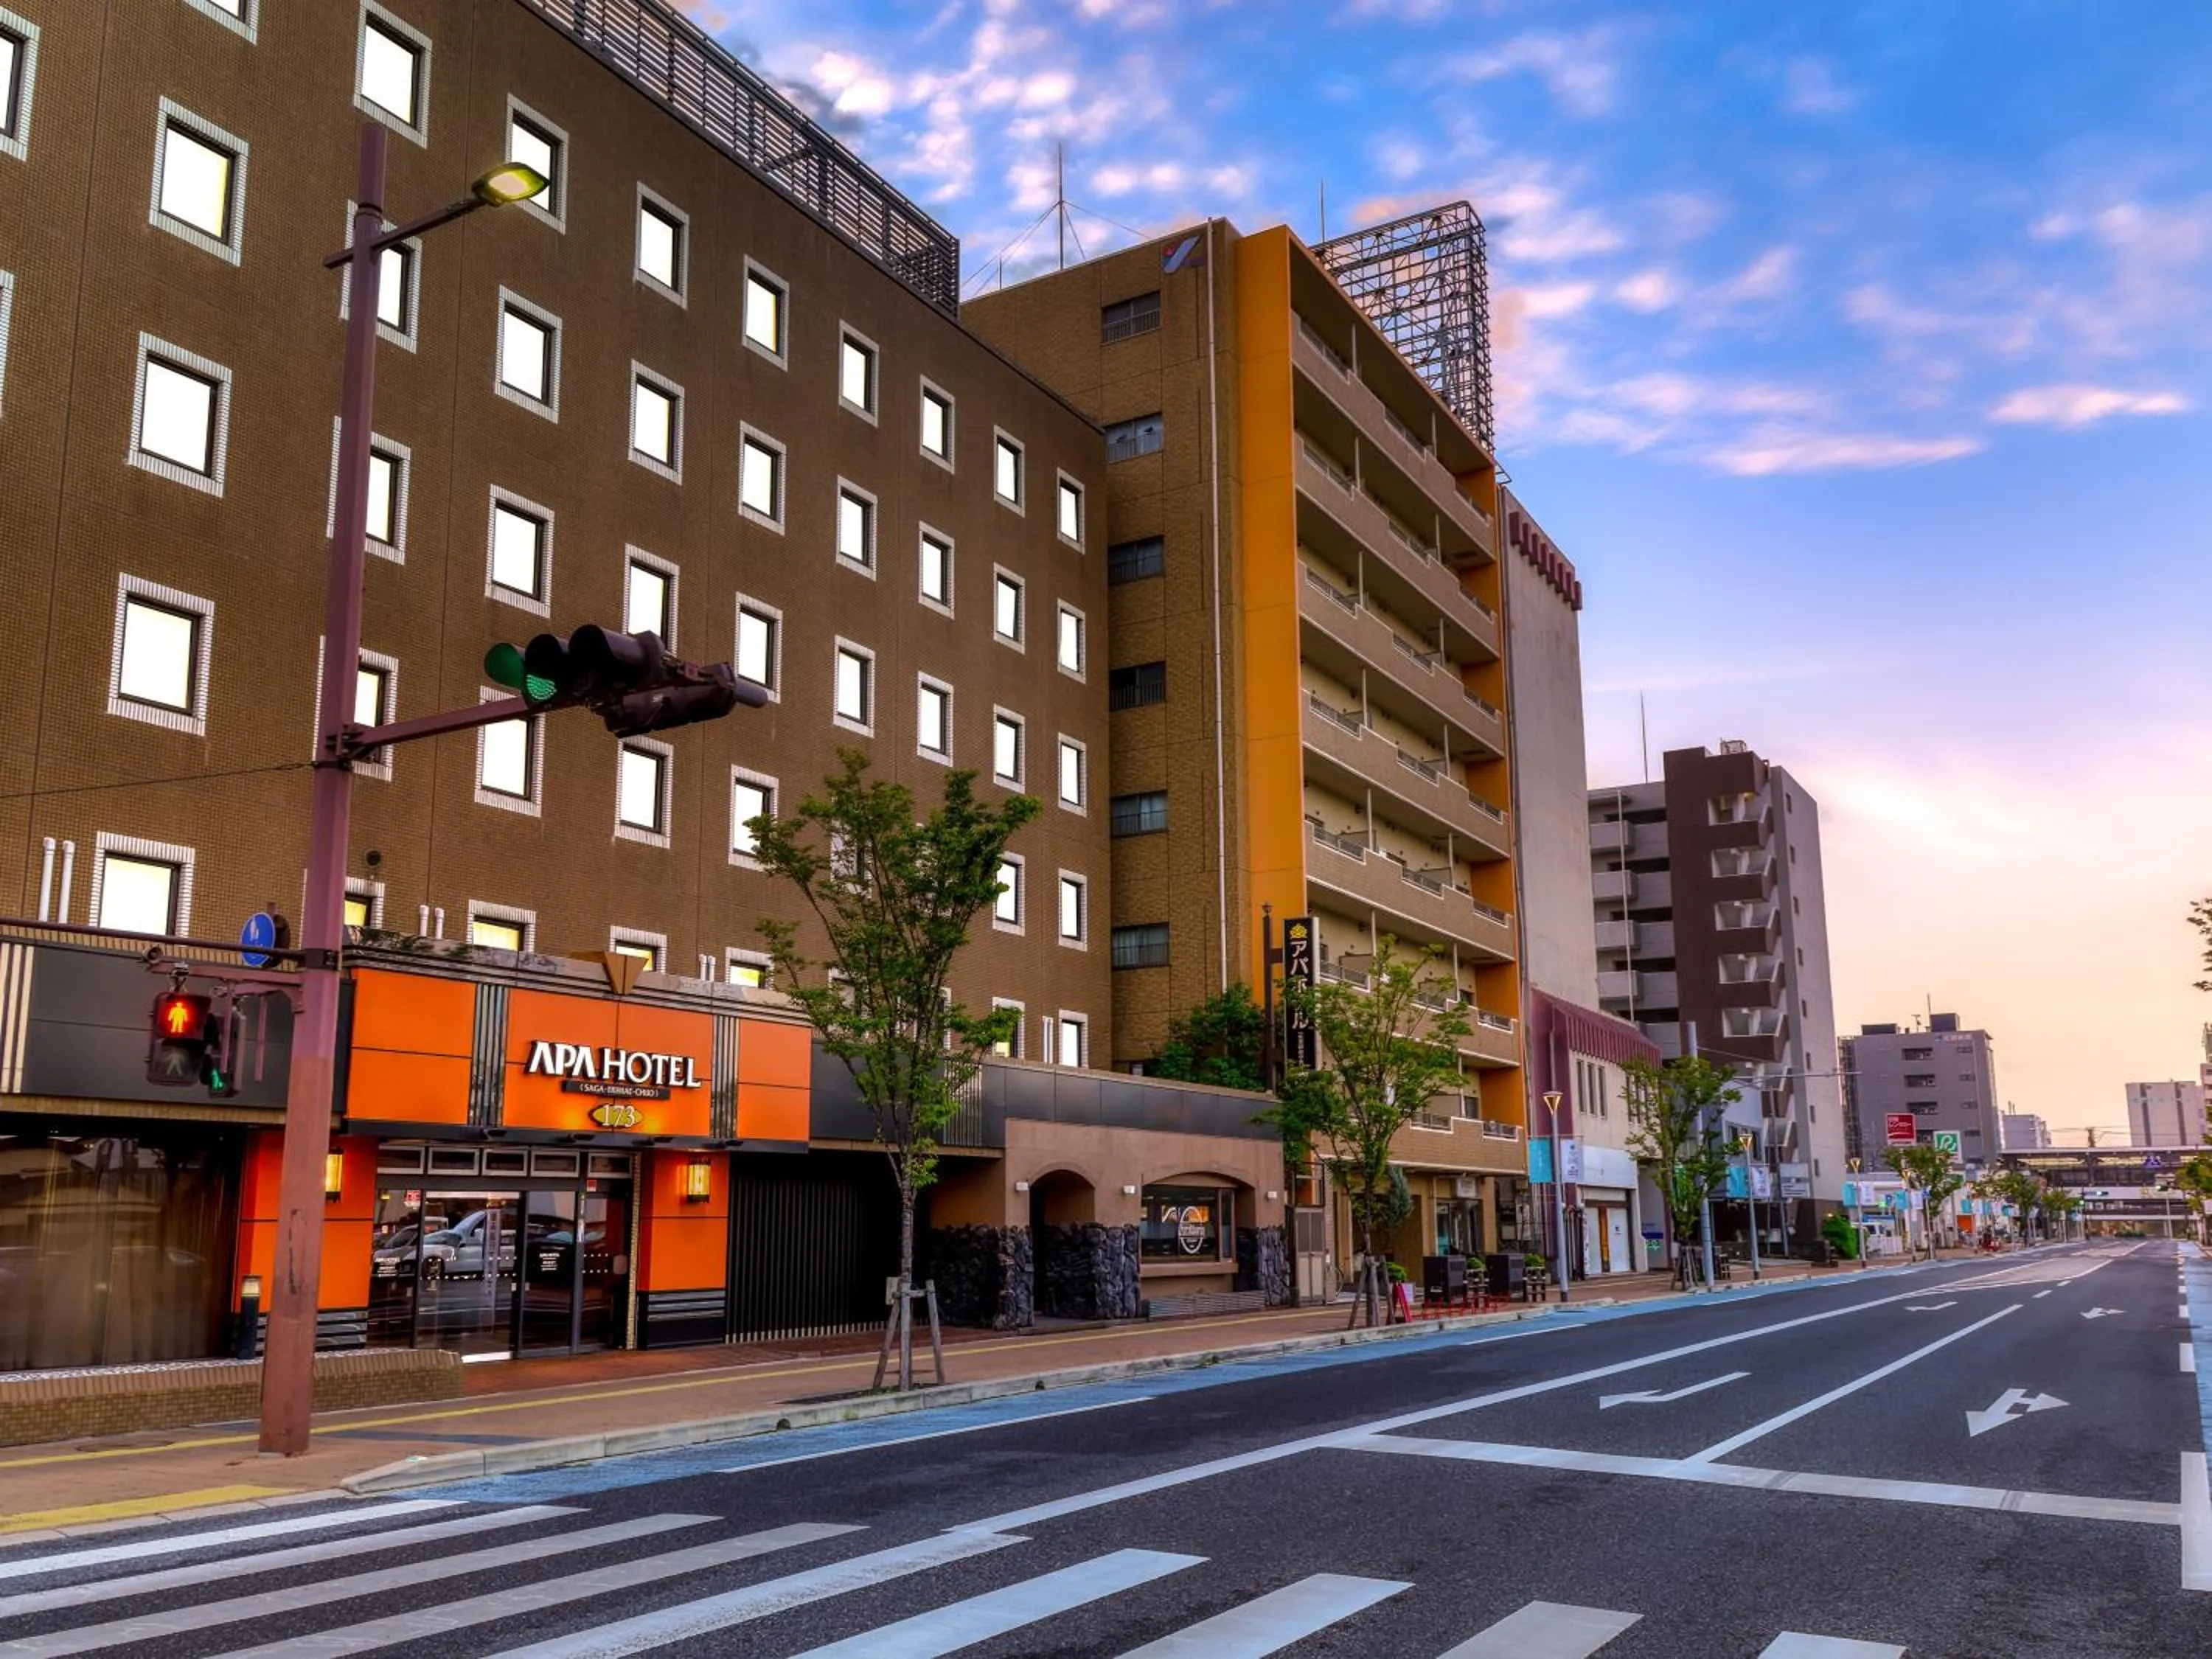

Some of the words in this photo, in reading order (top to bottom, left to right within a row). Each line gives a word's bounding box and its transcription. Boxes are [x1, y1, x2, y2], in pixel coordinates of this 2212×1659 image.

[1290, 940, 1309, 1030] アパホル
[528, 1041, 597, 1078] APA
[602, 1047, 702, 1088] HOTEL
[602, 1104, 636, 1127] 173
